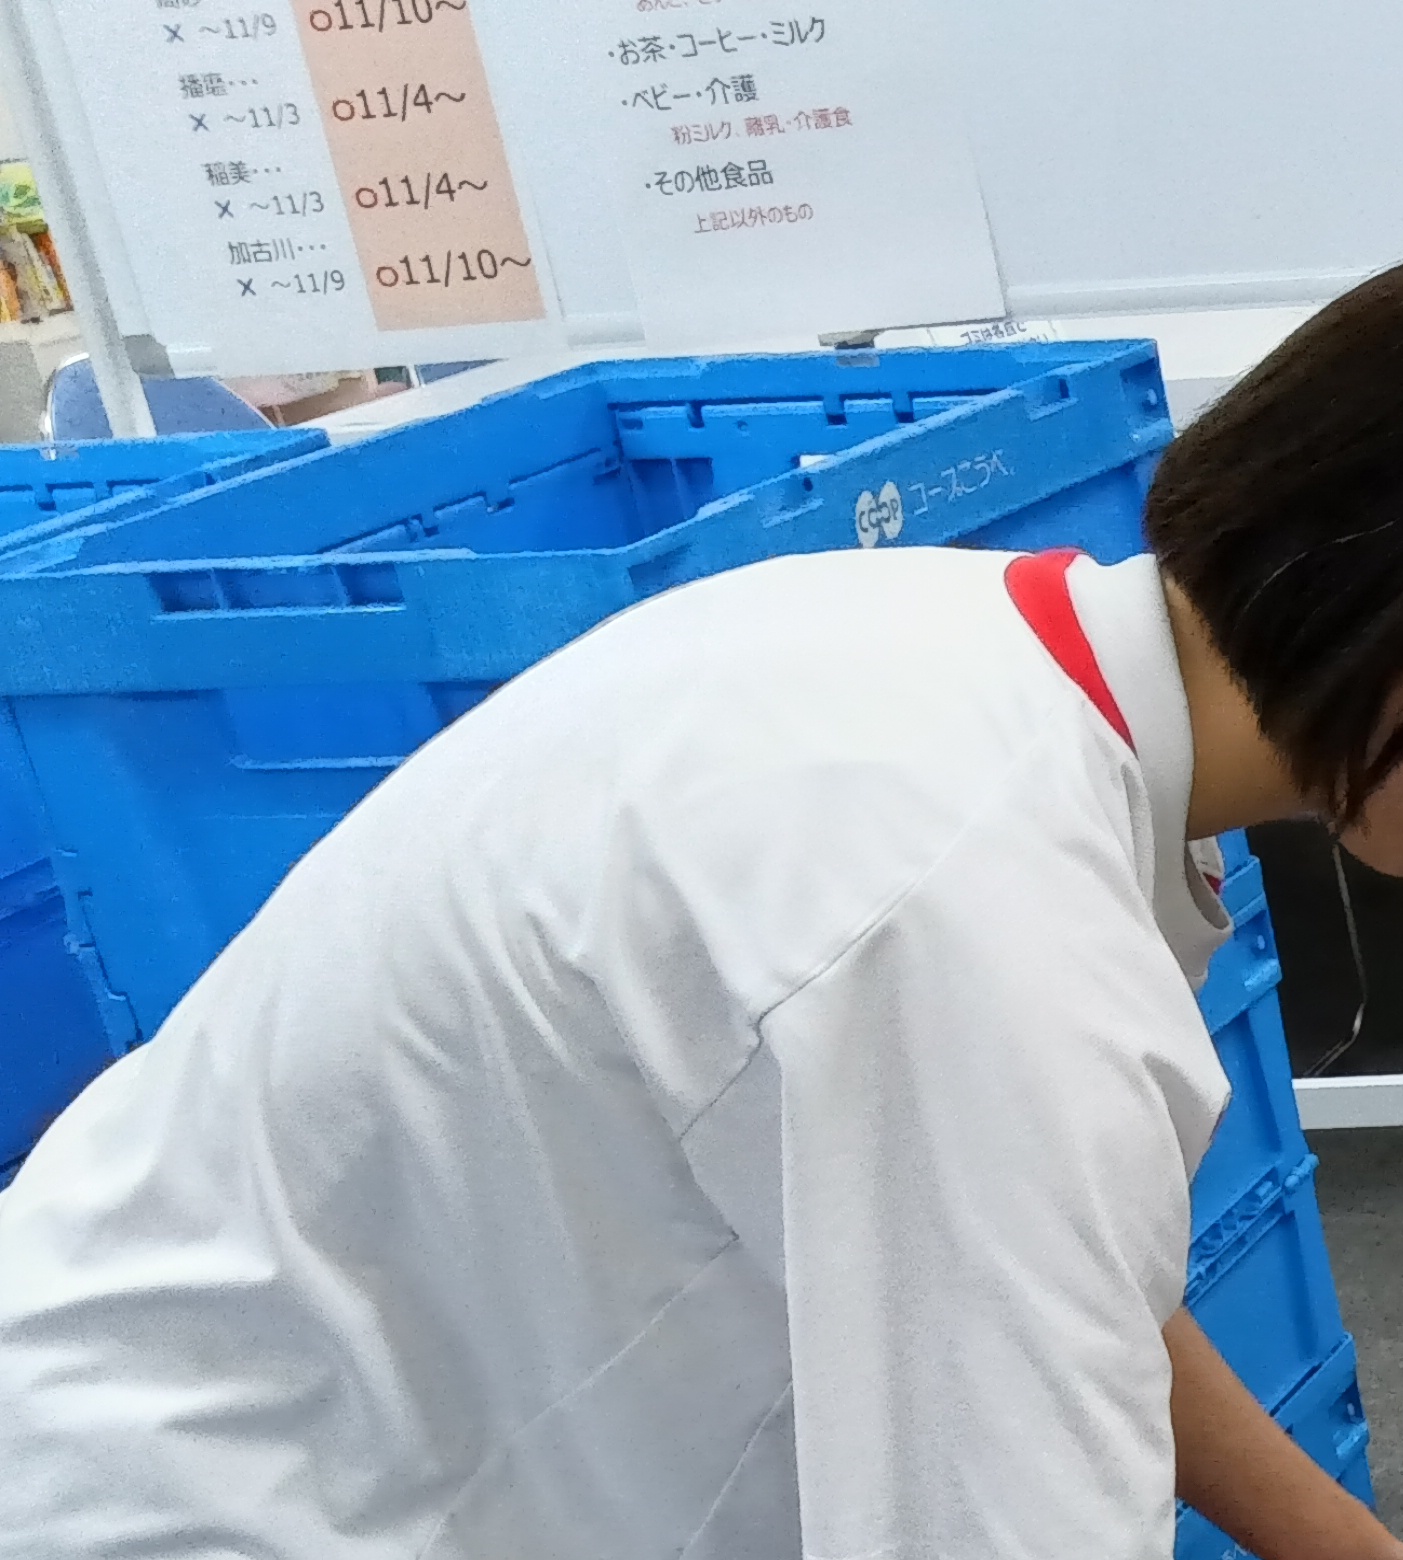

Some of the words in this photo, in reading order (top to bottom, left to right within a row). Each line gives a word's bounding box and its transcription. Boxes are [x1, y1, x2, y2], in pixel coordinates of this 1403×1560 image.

[694, 203, 814, 234] 上記以外のもの
